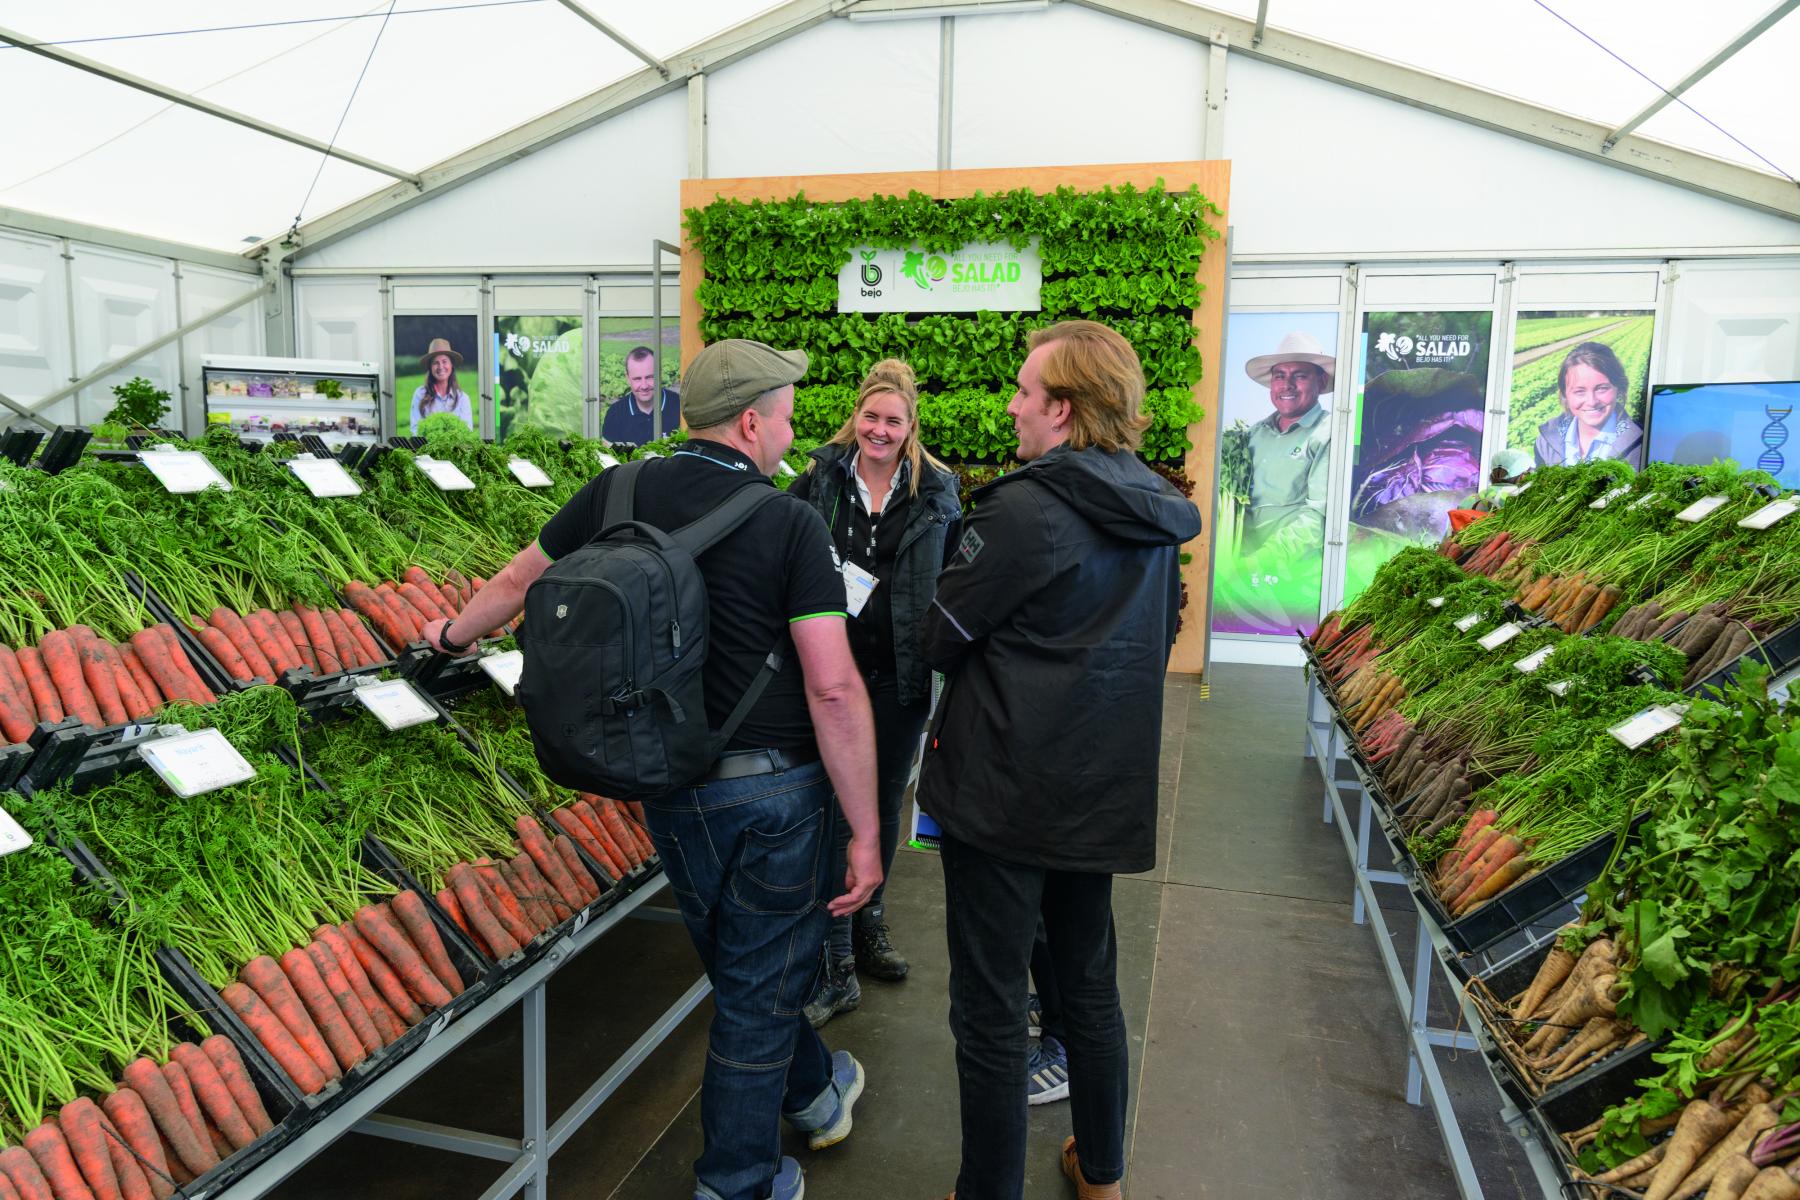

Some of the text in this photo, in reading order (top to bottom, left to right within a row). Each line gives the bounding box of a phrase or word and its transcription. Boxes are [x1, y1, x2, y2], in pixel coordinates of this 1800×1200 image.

[952, 261, 1020, 283] SALAD
[861, 287, 882, 298] bejo
[533, 340, 569, 353] SALAD
[1416, 341, 1471, 356] SALAD
